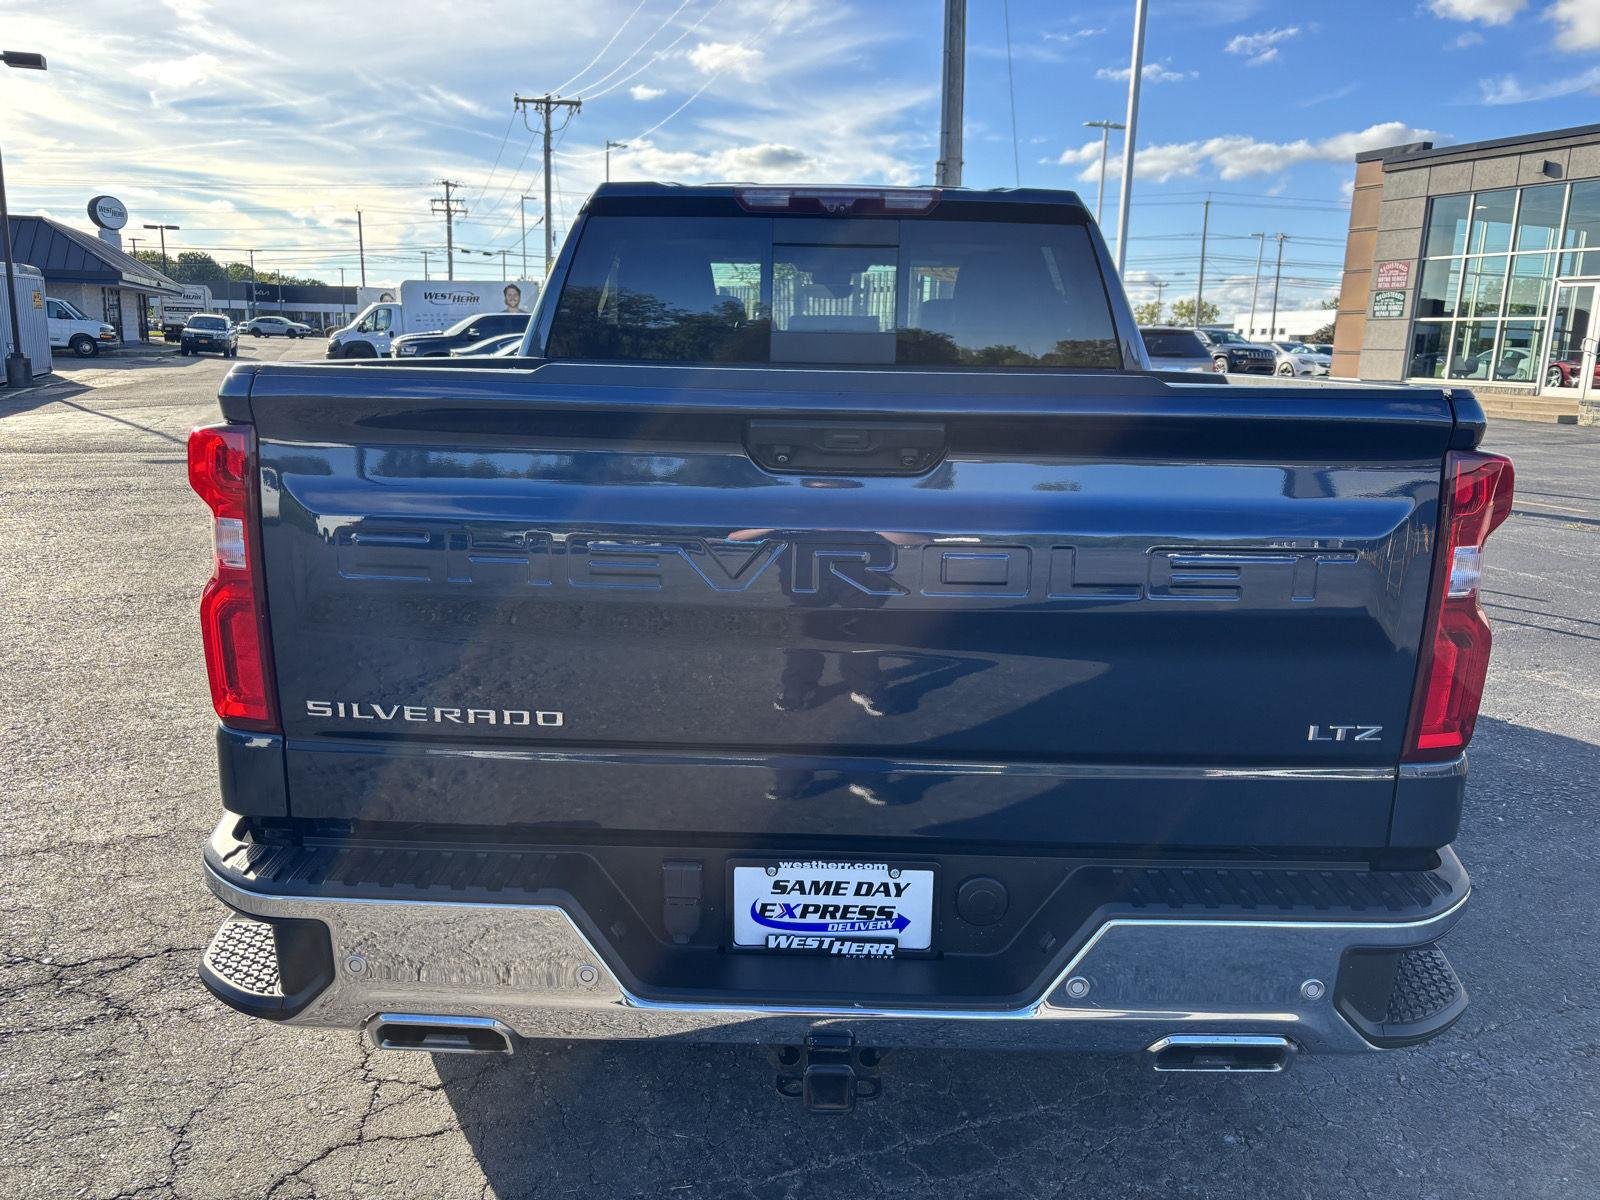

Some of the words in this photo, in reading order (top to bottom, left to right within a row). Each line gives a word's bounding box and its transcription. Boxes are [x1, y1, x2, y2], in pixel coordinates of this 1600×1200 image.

[424, 291, 454, 300] WEST
[452, 295, 480, 303] HERR
[337, 527, 1360, 601] CHEVROLET
[306, 700, 564, 727] SILVERADO
[1307, 725, 1383, 741] LTZ
[778, 860, 889, 871] westherr.com
[770, 879, 850, 896] SAME
[853, 881, 912, 898] DAY
[758, 902, 897, 921] EXPRESS
[827, 919, 896, 932] DELIVERY
[767, 935, 836, 949] WEST
[830, 941, 896, 955] HERR
